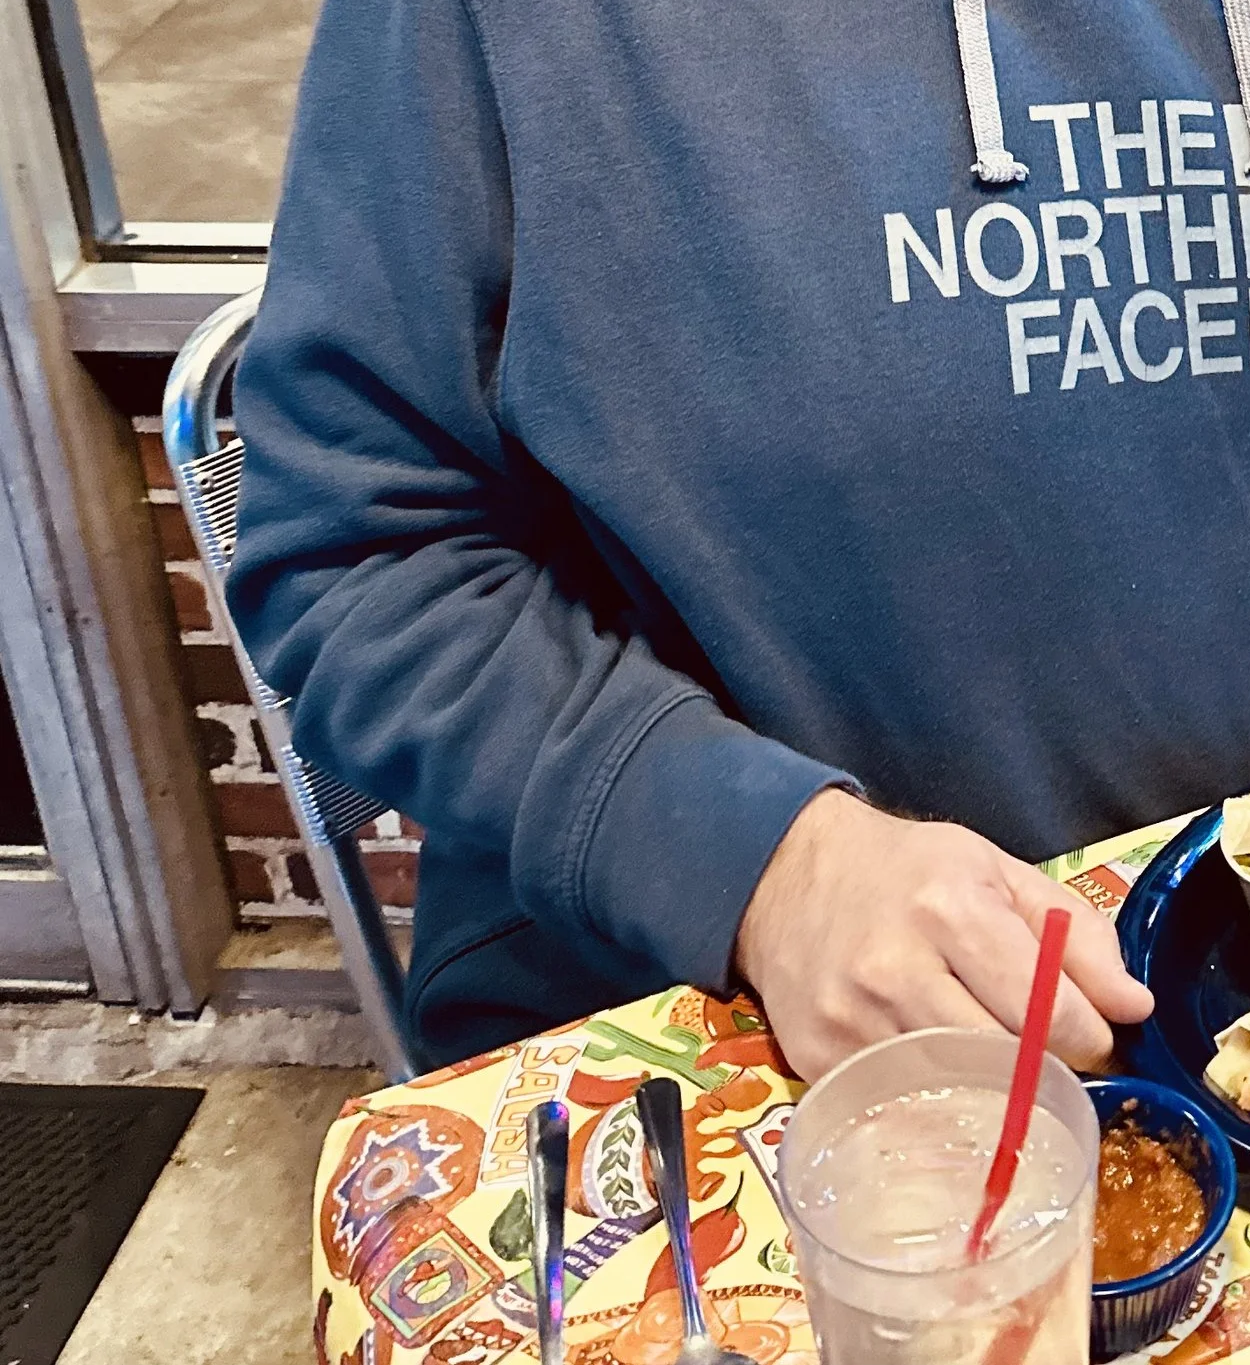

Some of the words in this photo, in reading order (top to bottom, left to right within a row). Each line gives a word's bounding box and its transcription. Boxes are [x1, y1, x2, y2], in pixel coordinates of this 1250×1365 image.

[1029, 99, 1225, 192] THE
[884, 193, 1237, 304] NORTH
[1005, 286, 1243, 395] FACE
